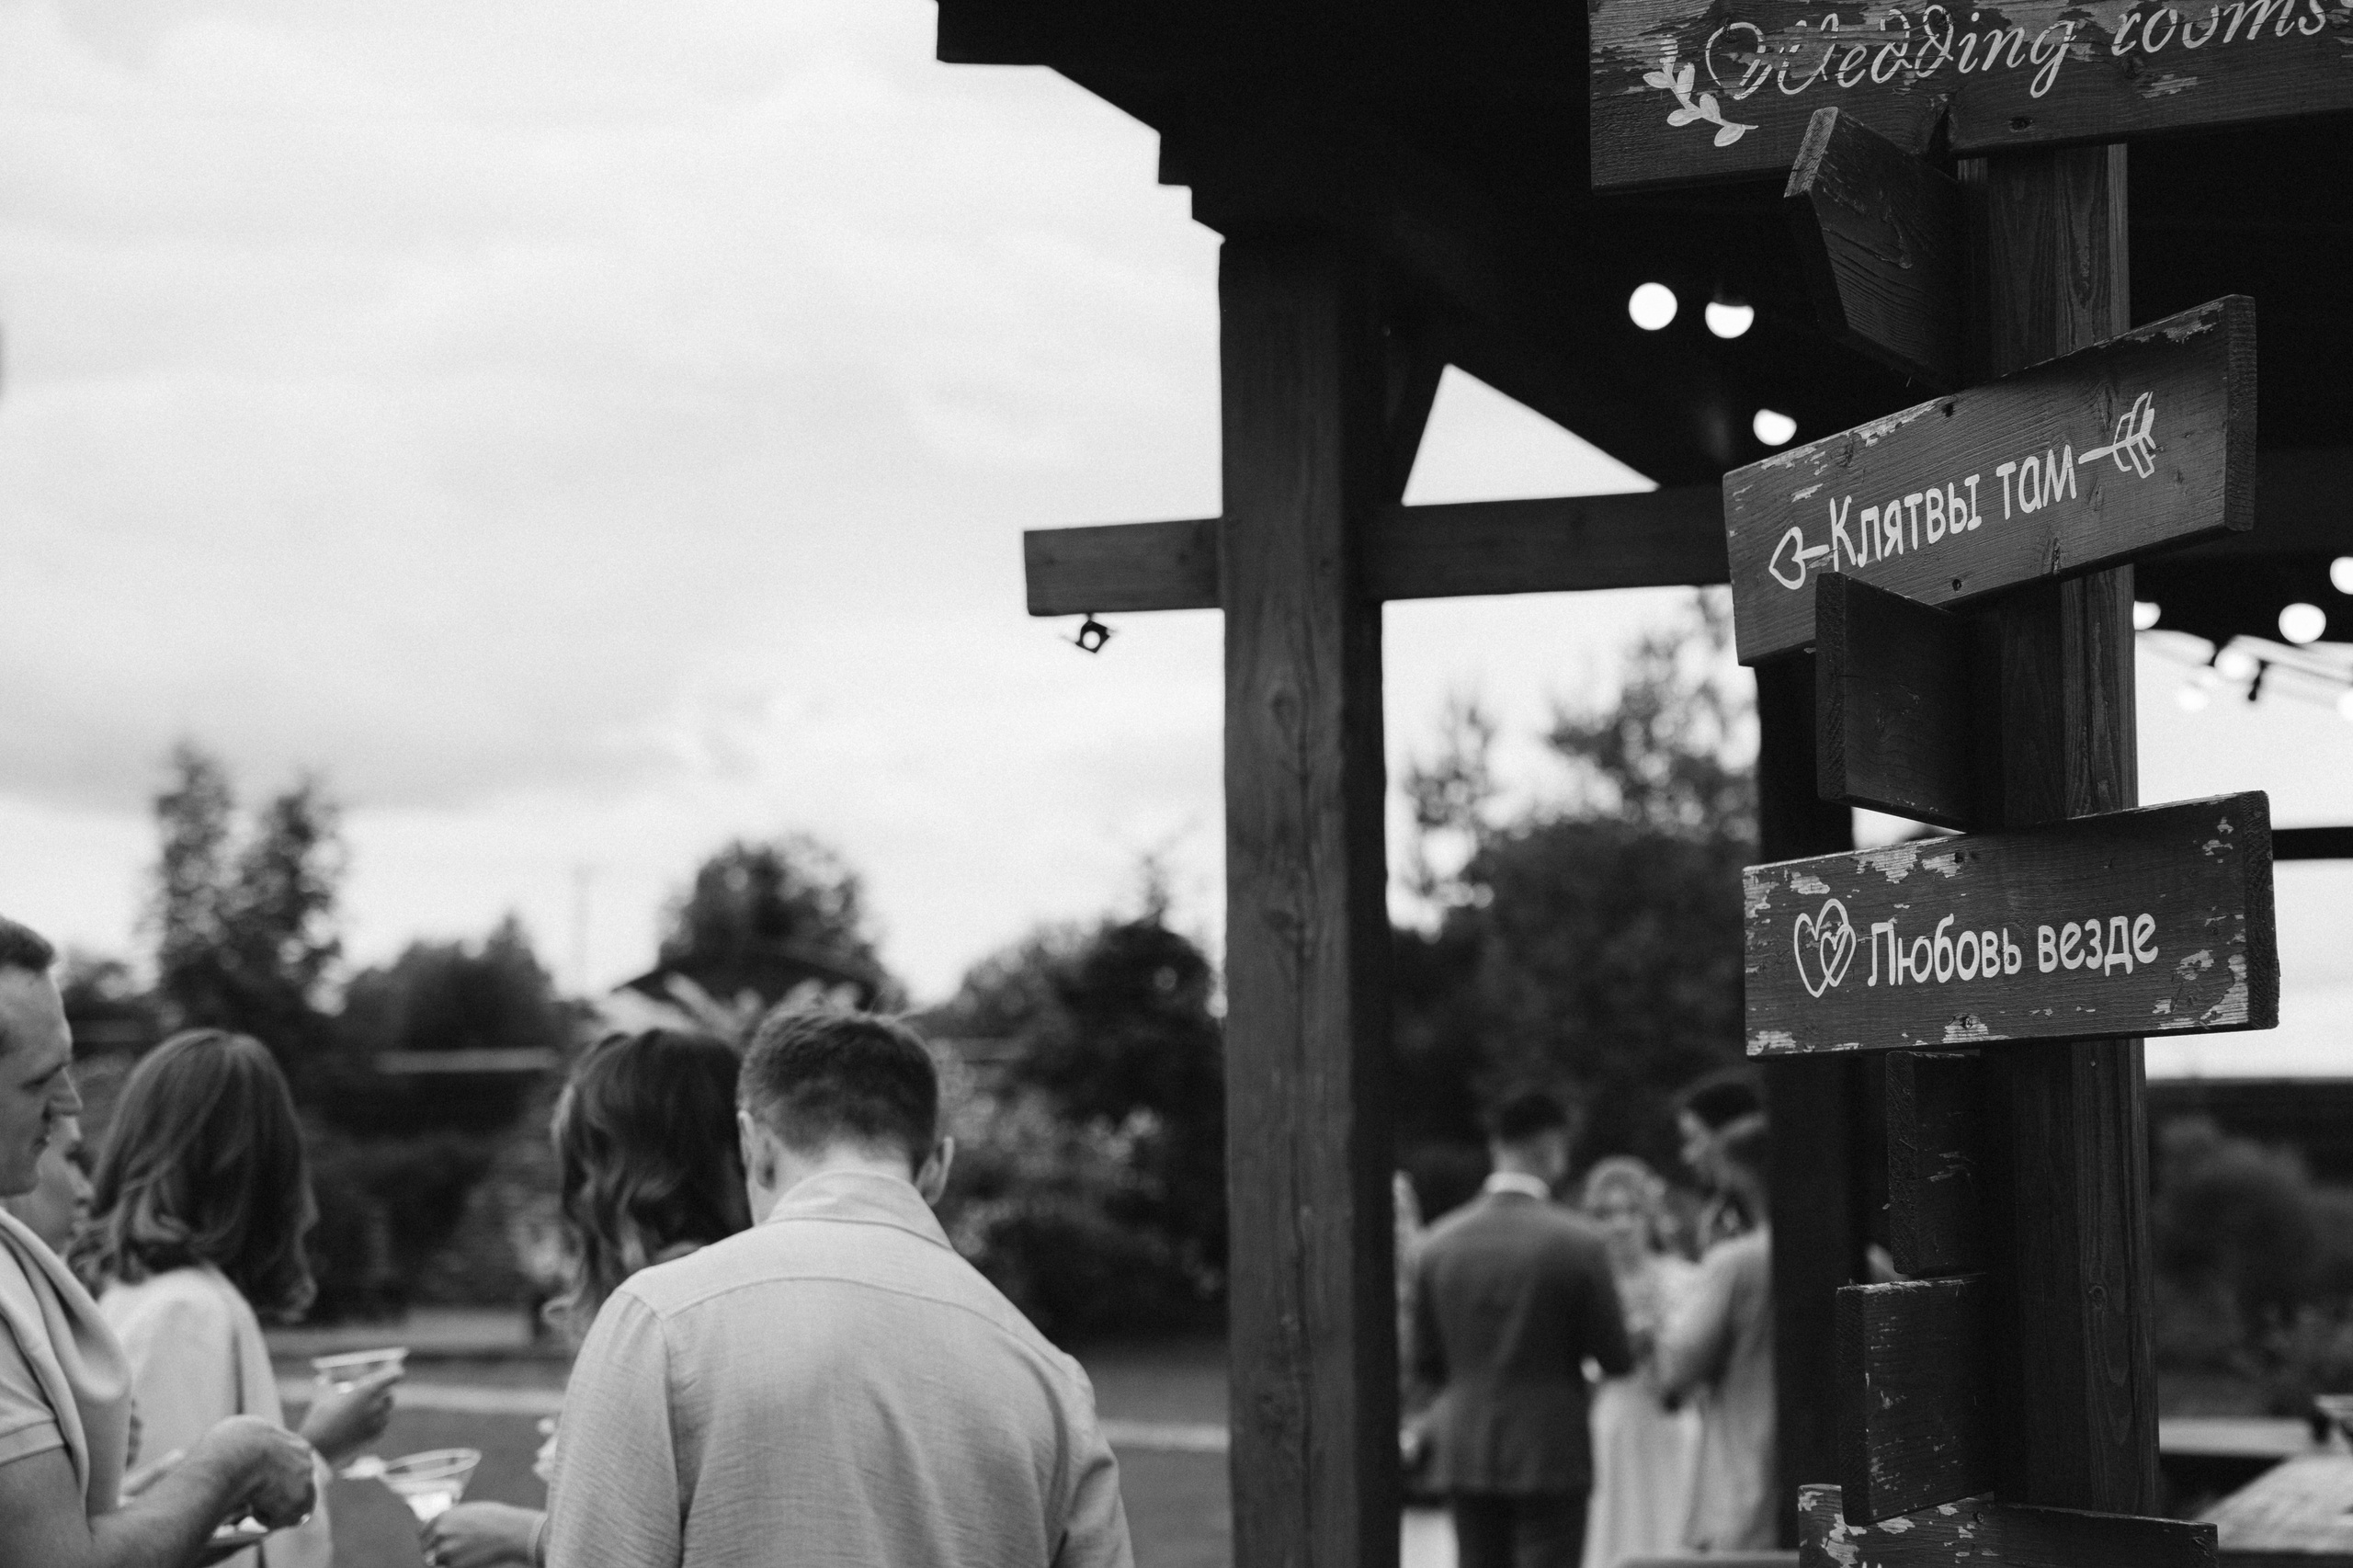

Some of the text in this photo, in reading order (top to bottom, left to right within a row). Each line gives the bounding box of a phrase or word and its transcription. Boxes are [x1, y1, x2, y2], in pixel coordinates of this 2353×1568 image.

[2111, 0, 2326, 56] rooms
[1829, 444, 2078, 572] Клятвы там
[1868, 913, 2160, 987] Любовь везде
